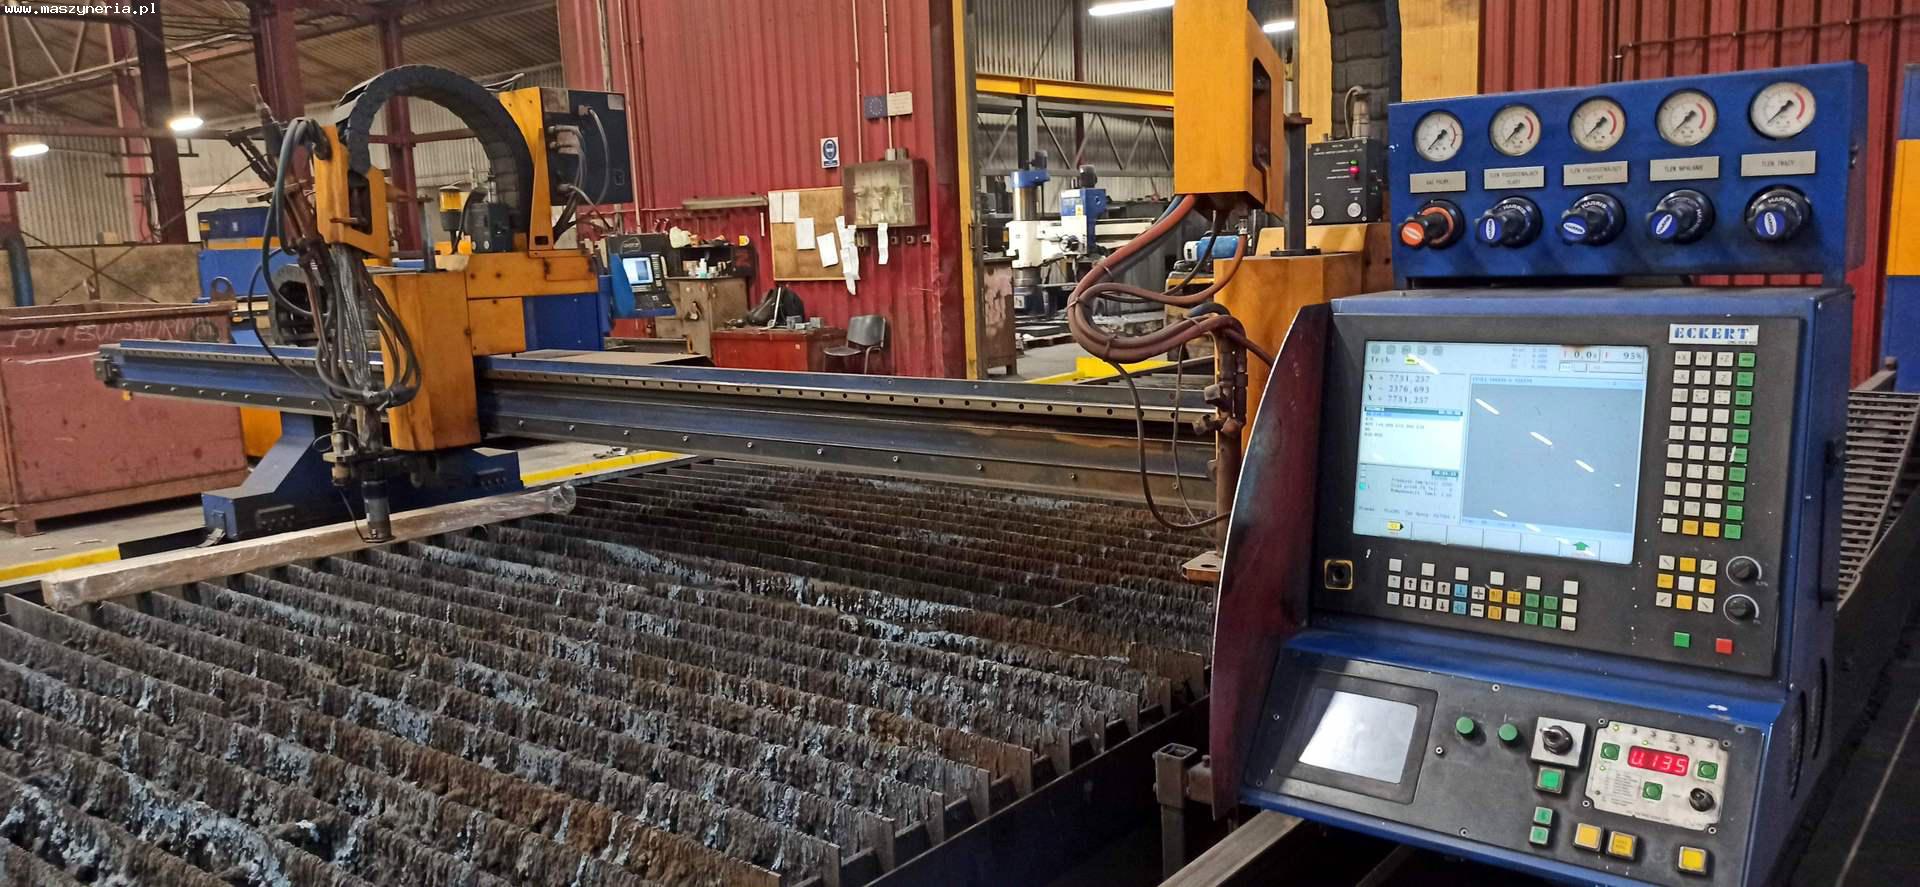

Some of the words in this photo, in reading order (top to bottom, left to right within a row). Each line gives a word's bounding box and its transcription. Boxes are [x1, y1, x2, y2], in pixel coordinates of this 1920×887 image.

[1581, 201, 1608, 209] HARRIS
[1768, 197, 1797, 208] HARRIS
[1674, 328, 1749, 340] ECKERT
